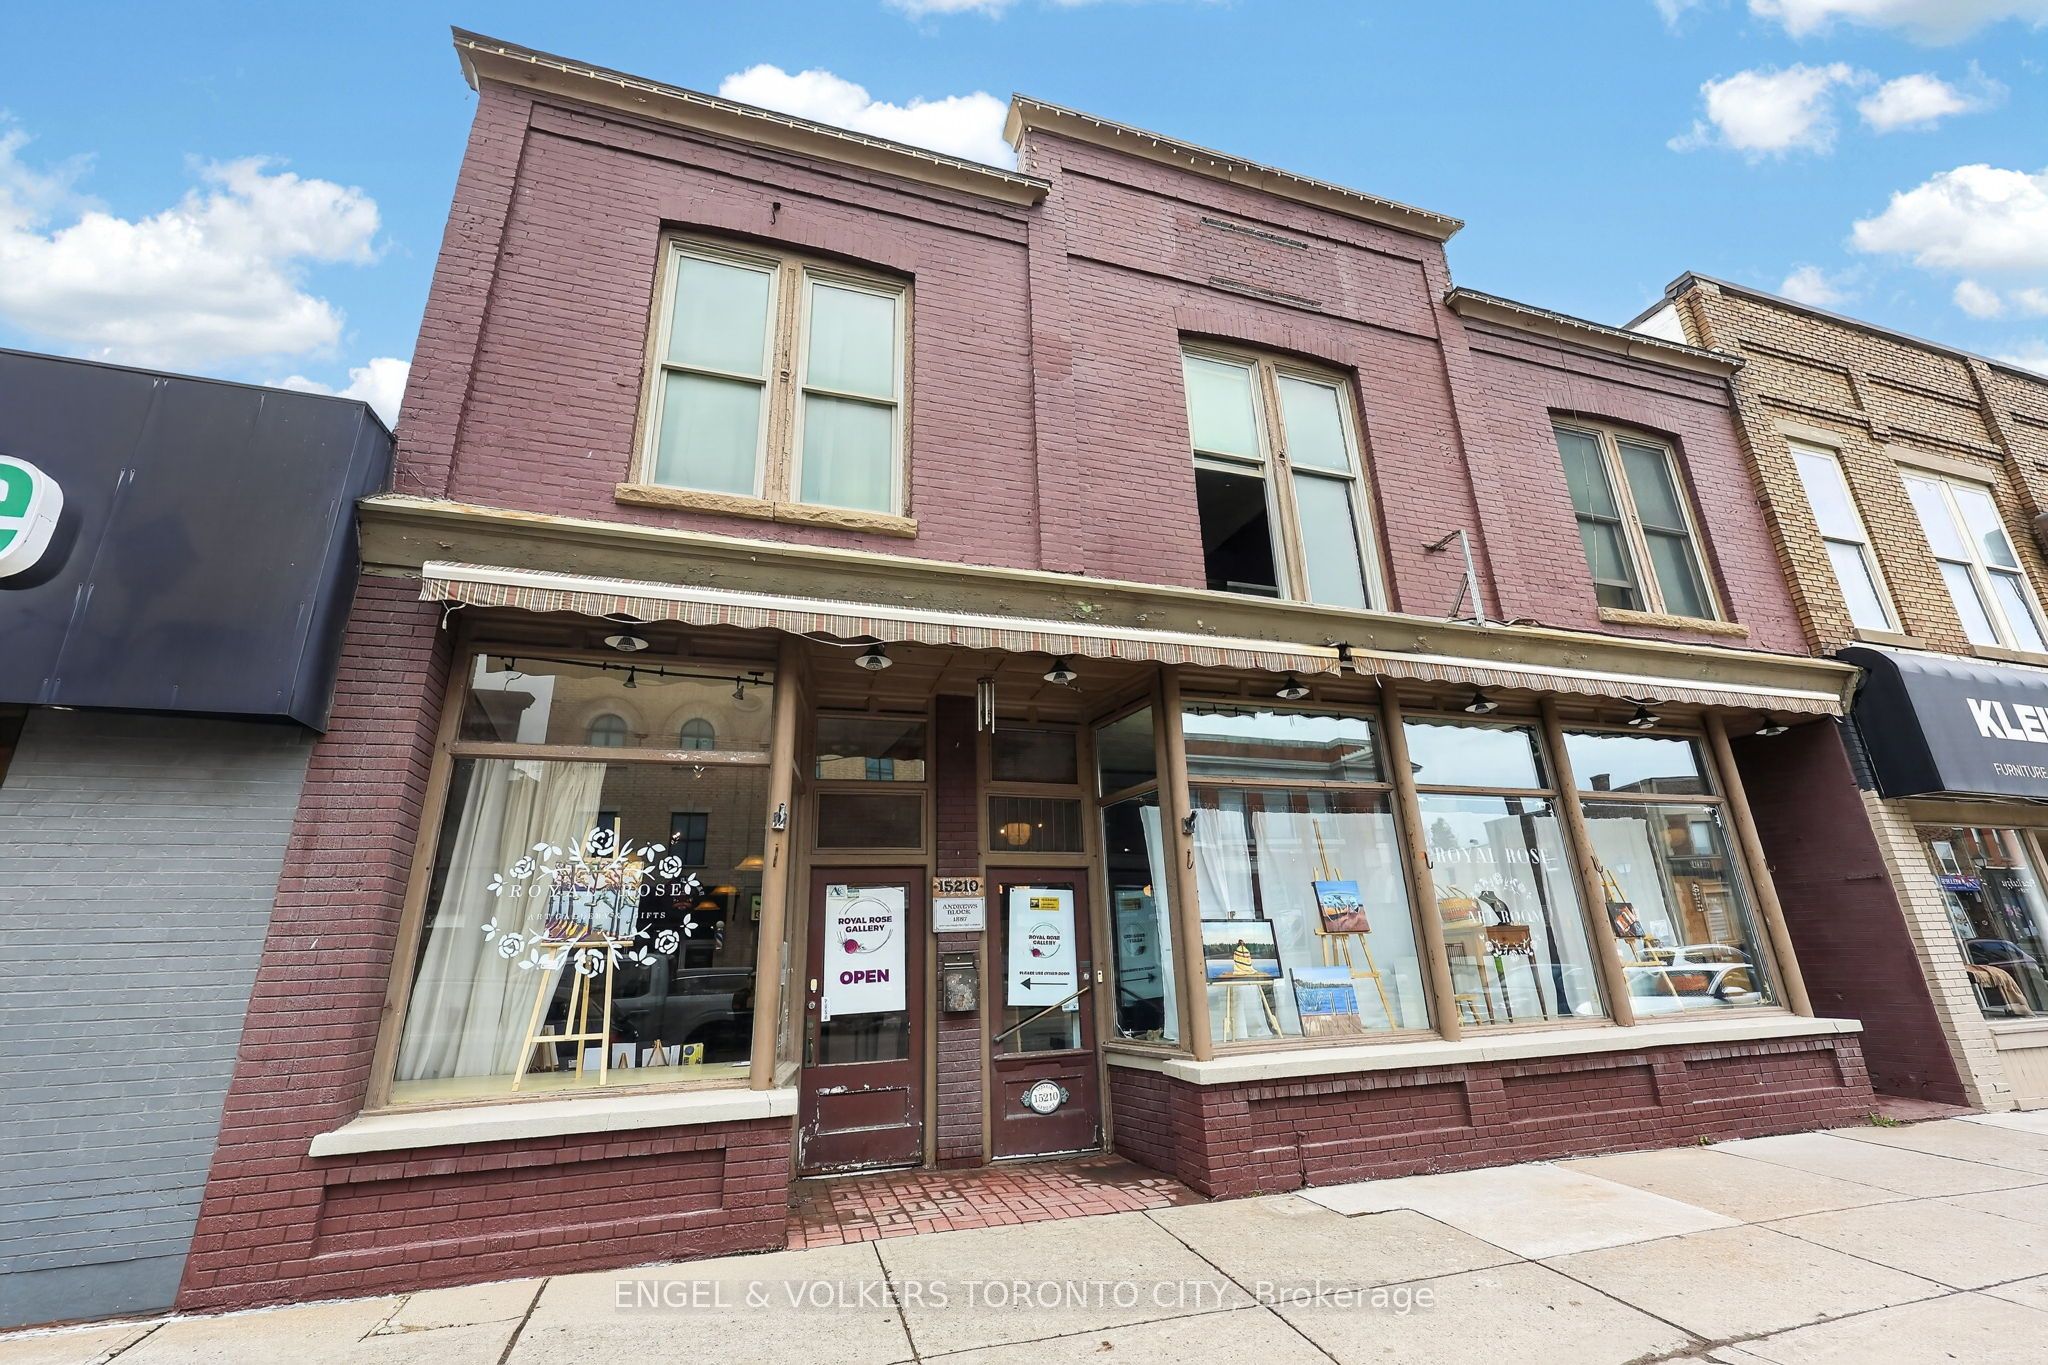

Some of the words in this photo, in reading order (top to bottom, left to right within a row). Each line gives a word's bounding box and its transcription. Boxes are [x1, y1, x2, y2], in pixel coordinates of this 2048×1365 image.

[1993, 762, 2048, 779] FURNITURE
[1434, 847, 1498, 864] ROYAL
[1505, 847, 1551, 864] ROSE
[508, 883, 596, 897] ROYAL
[619, 883, 682, 897] ROSE
[938, 879, 979, 893] 15210
[838, 917, 867, 925] ROYAL
[869, 915, 893, 923] ROSE
[845, 924, 885, 933] GALLERY
[839, 968, 890, 985] OPEN
[1033, 1091, 1059, 1104] 15210
